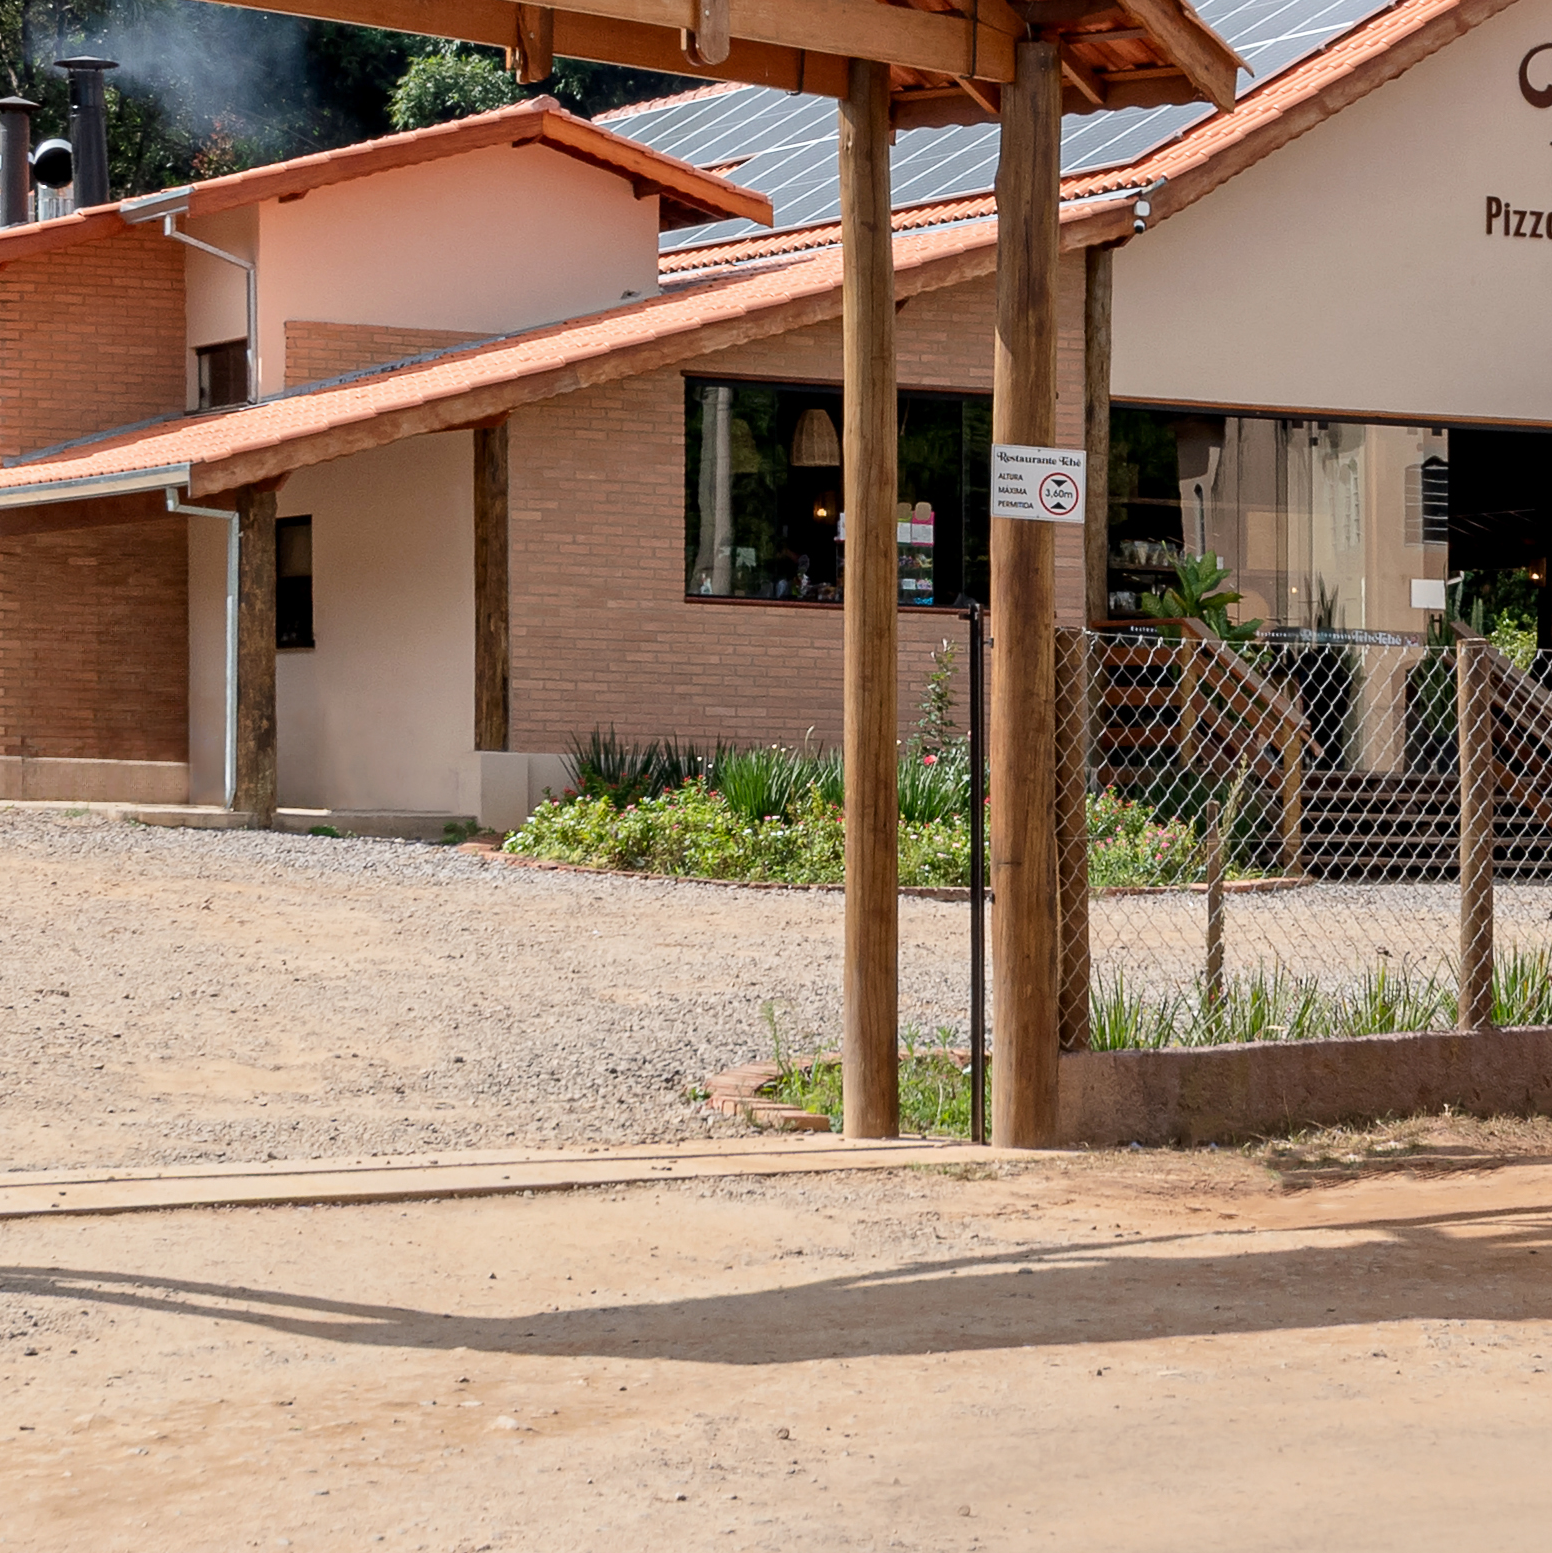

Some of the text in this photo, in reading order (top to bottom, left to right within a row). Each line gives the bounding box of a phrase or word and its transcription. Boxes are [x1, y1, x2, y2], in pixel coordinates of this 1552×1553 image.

[997, 451, 1057, 465] Restaurante
[998, 473, 1024, 481] ALTURA
[998, 485, 1028, 495] MÁXIMA
[1045, 488, 1073, 499] 3,60m
[998, 500, 1034, 509] PERMITIDA
